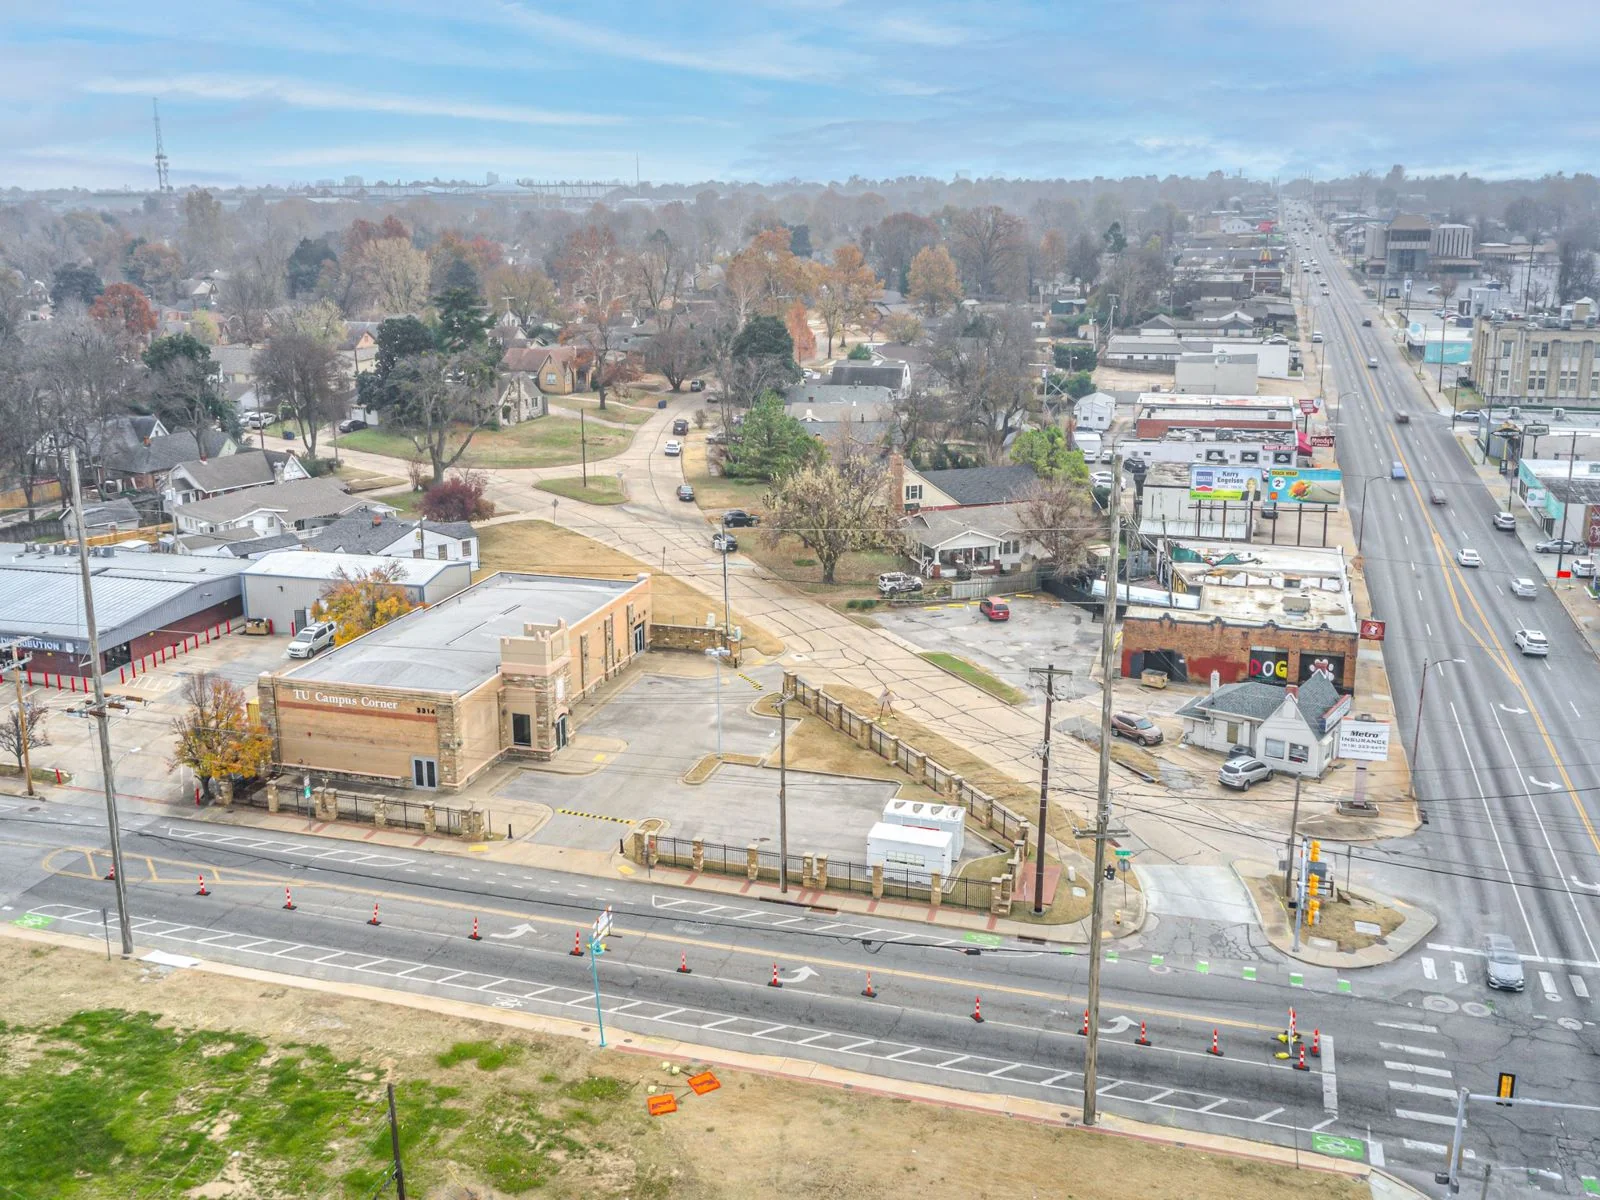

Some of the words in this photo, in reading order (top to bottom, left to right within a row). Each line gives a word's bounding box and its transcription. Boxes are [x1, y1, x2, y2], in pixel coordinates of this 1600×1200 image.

[1250, 659, 1288, 679] DOG
[293, 689, 310, 700] TU
[315, 692, 357, 707] Campus
[361, 696, 399, 710] Corner
[416, 707, 436, 715] 3314
[1350, 730, 1379, 739] Metro
[1341, 736, 1387, 745] INSURANCE
